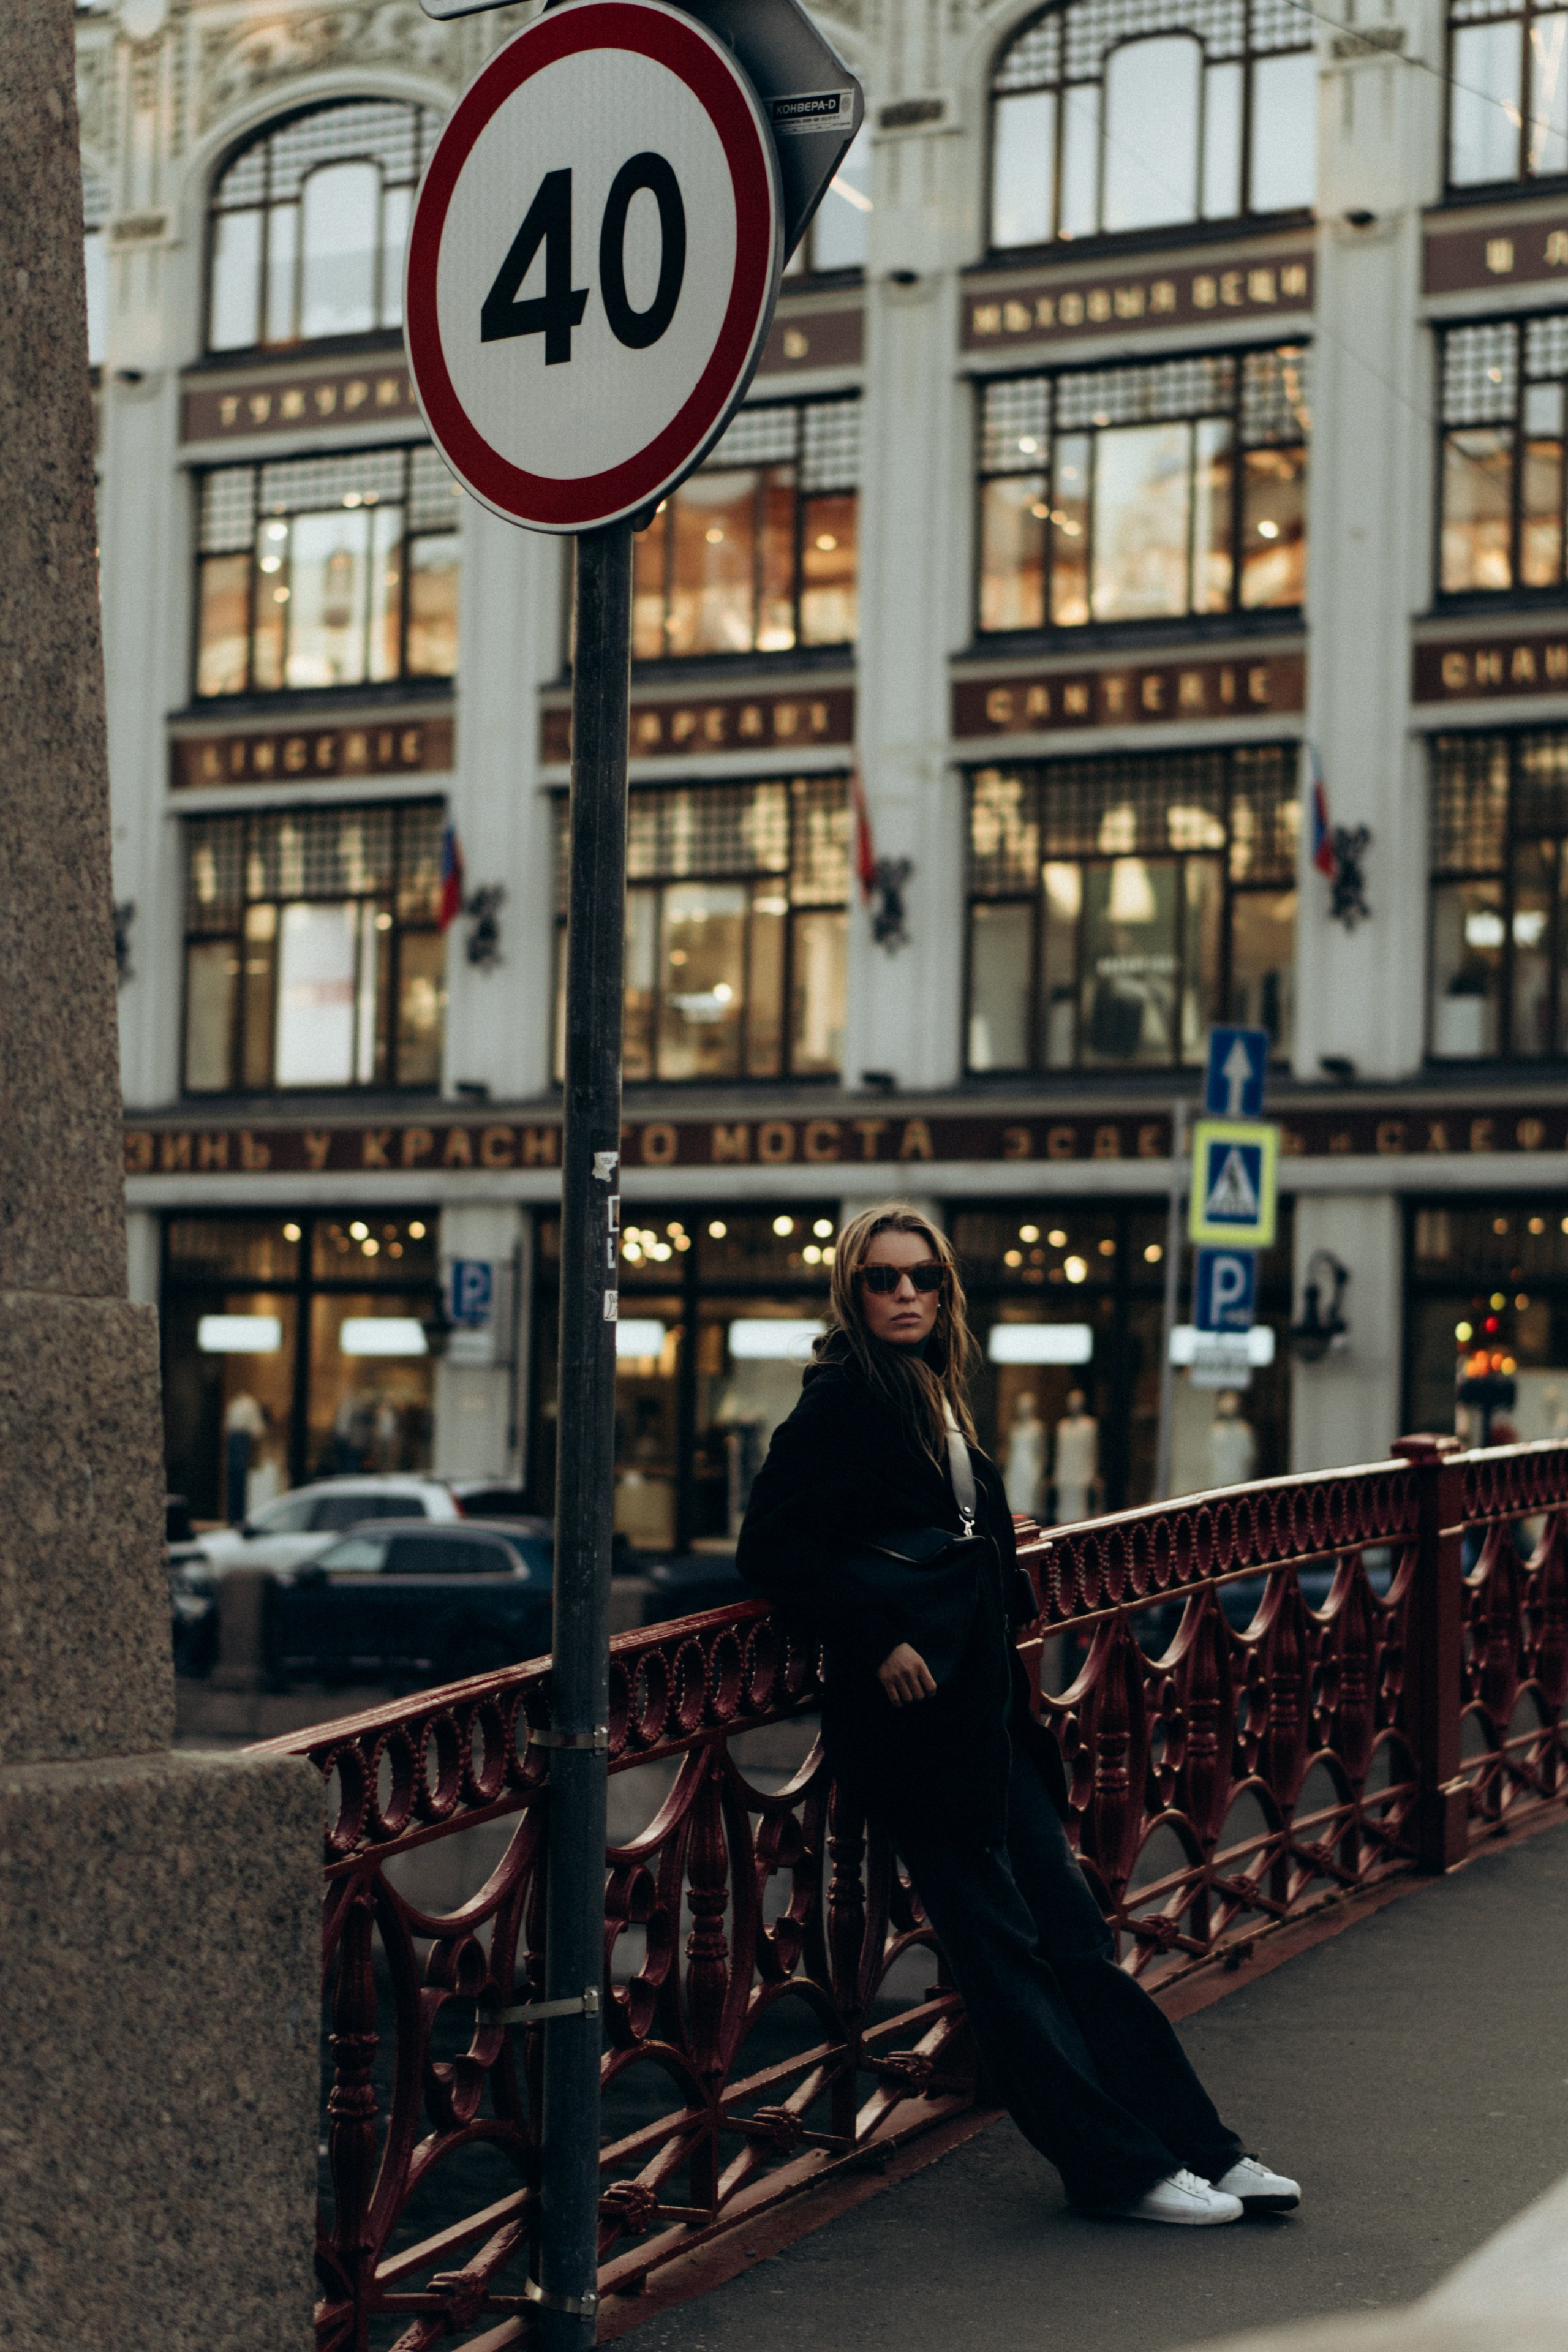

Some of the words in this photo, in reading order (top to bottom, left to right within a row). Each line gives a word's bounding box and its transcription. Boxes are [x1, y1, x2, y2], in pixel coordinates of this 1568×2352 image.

[480, 151, 687, 366] 40
[304, 1131, 331, 1169] У
[711, 1118, 933, 1165] МОСТА
